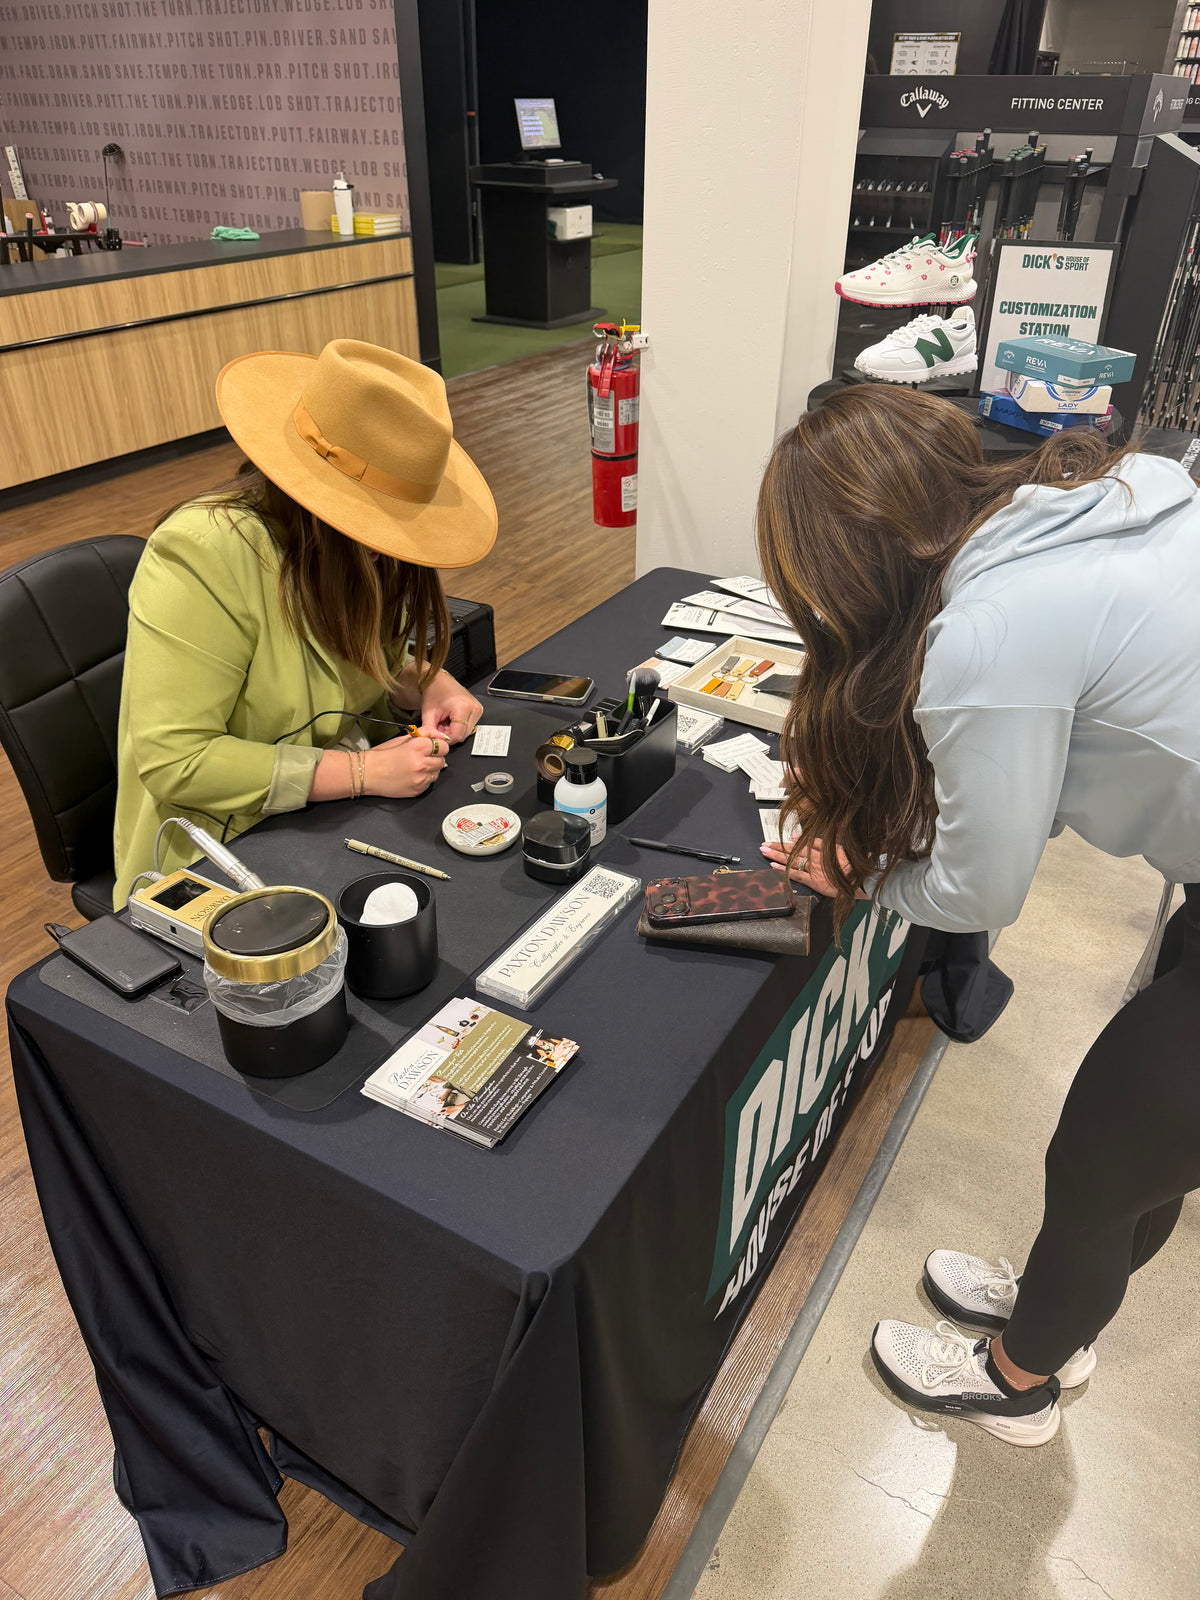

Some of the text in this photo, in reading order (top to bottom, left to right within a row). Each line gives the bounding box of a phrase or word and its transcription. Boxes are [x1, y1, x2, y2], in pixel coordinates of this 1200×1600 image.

[900, 86, 949, 109] Callaway
[1010, 97, 1104, 111] FITTING CENTER
[1022, 252, 1065, 270] DICK'S
[1064, 262, 1090, 272] SPORT
[999, 301, 1098, 319] CUSTOMIZATION
[1019, 321, 1070, 338] STATION
[1026, 355, 1047, 368] REVA
[498, 893, 591, 977] PAXTON DAWSON
[398, 1050, 439, 1090] DAWSON
[713, 1138, 811, 1321] HOUSE
[962, 1391, 1002, 1402] BROOKS
